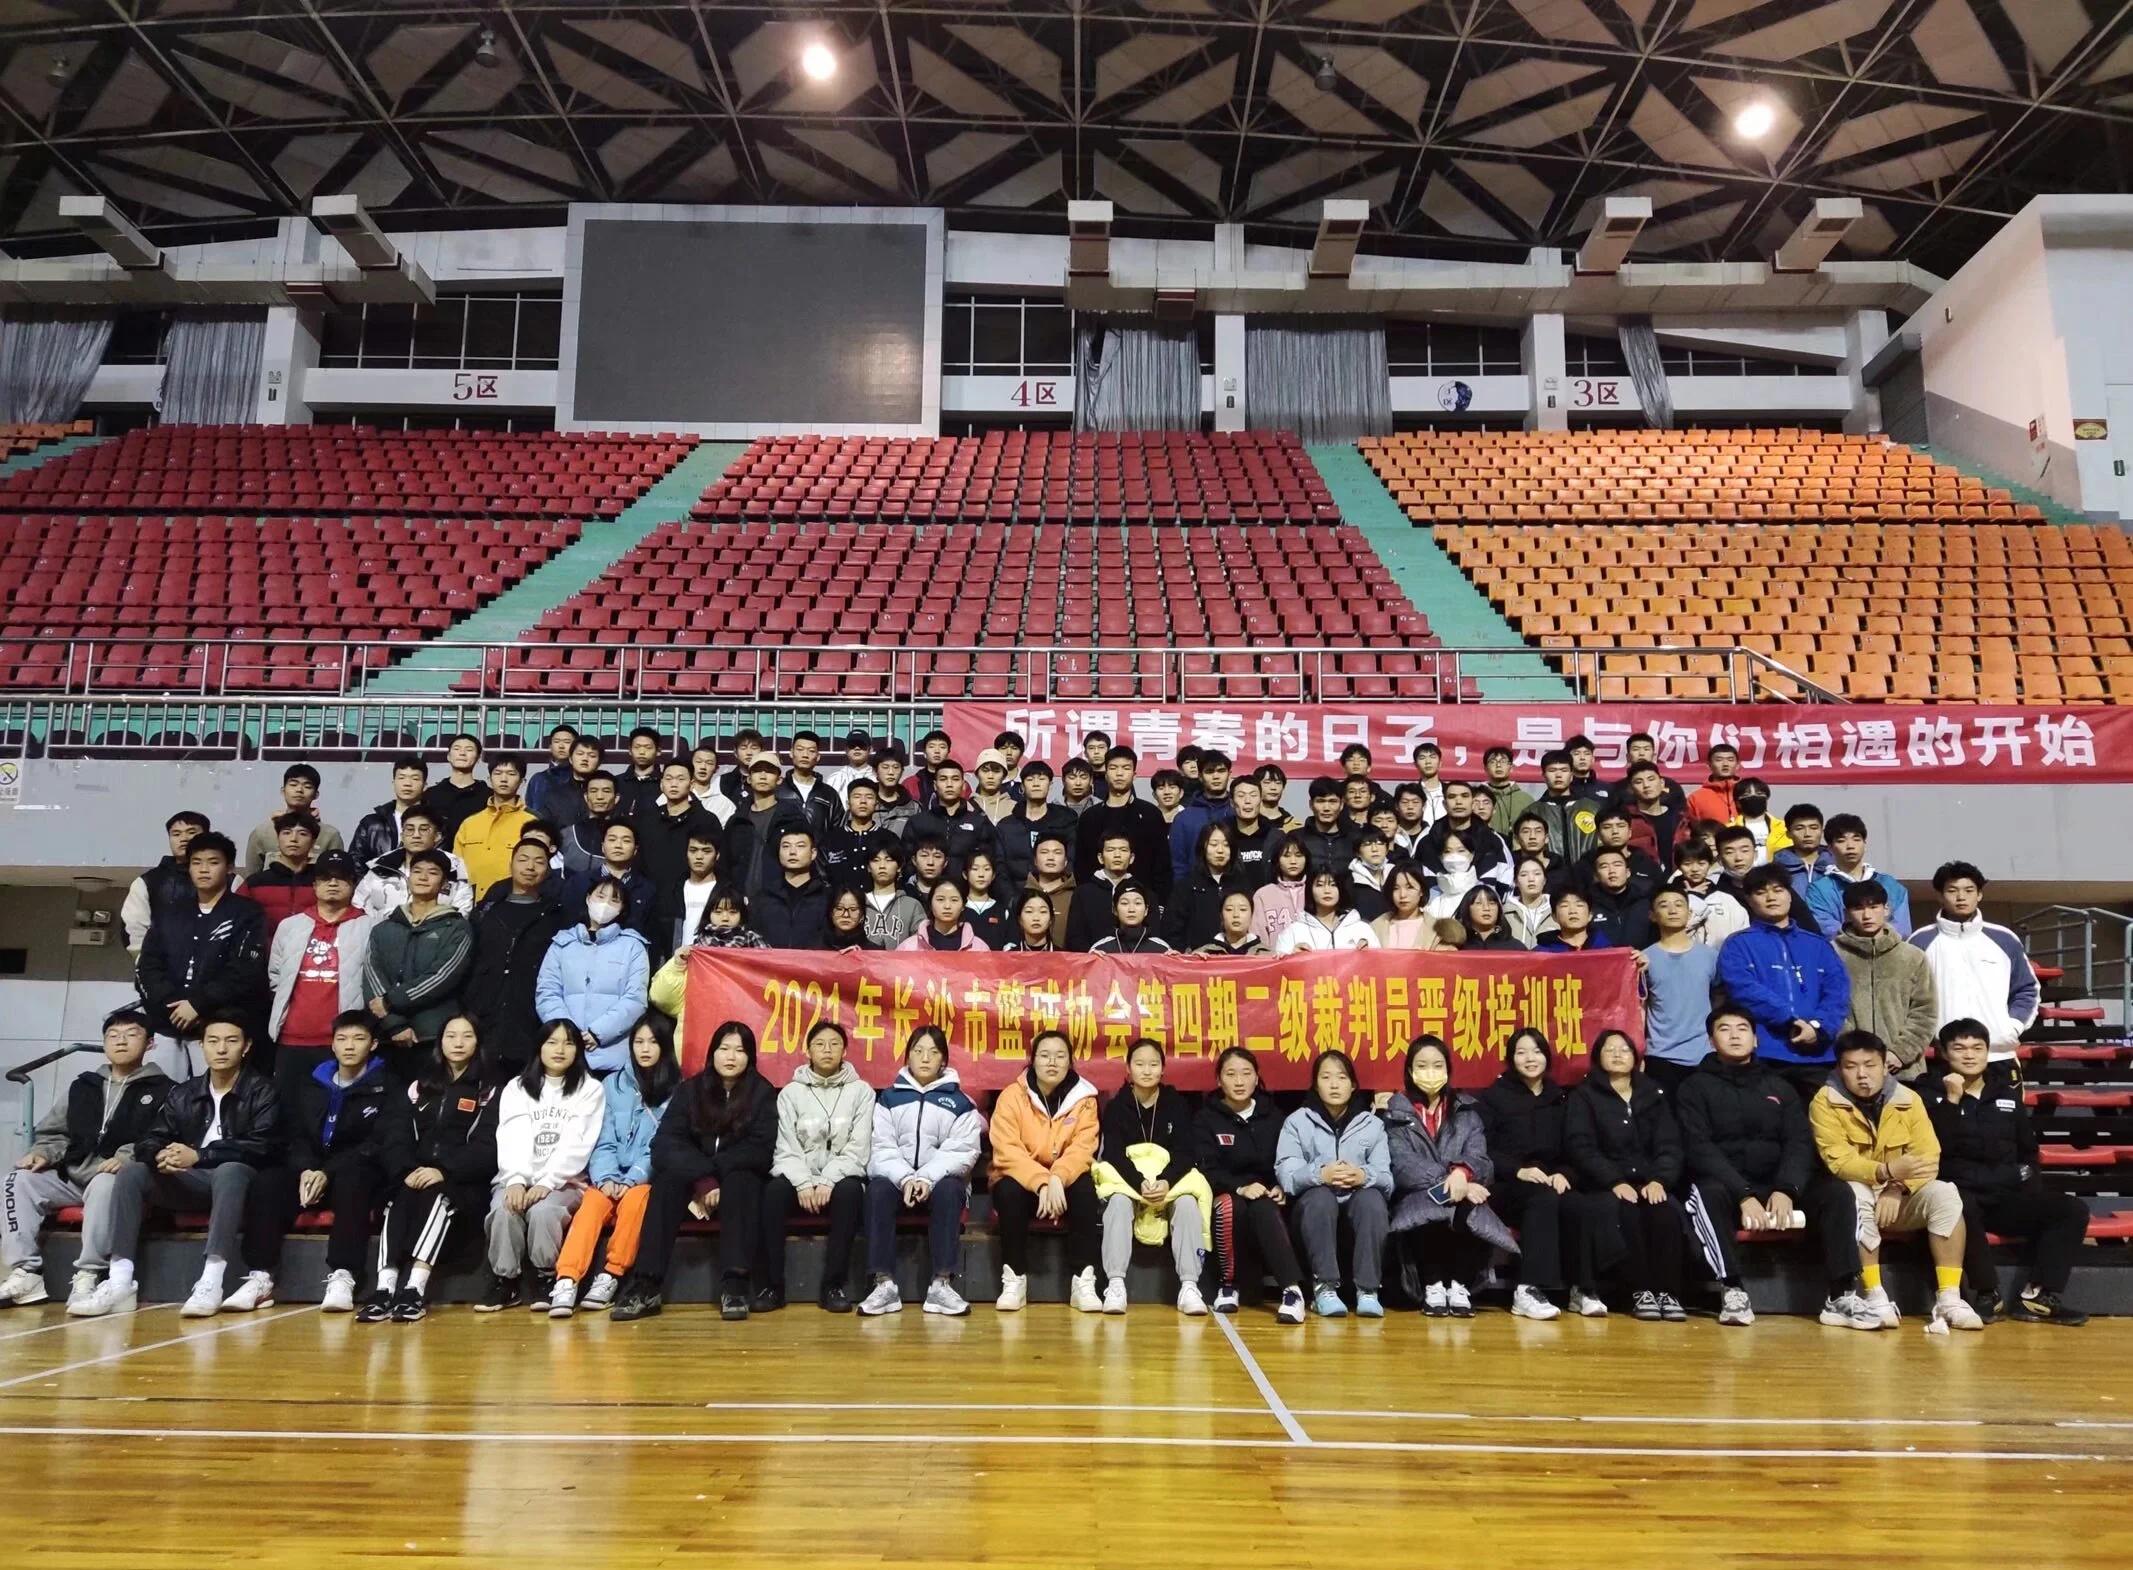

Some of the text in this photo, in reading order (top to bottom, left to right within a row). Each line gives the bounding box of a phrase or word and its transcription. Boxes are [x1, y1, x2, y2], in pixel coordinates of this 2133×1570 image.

[453, 373, 498, 400] 5区
[1011, 380, 1056, 407] 4区
[1574, 379, 1620, 407] 3区
[5, 1172, 19, 1233] RMOUR
